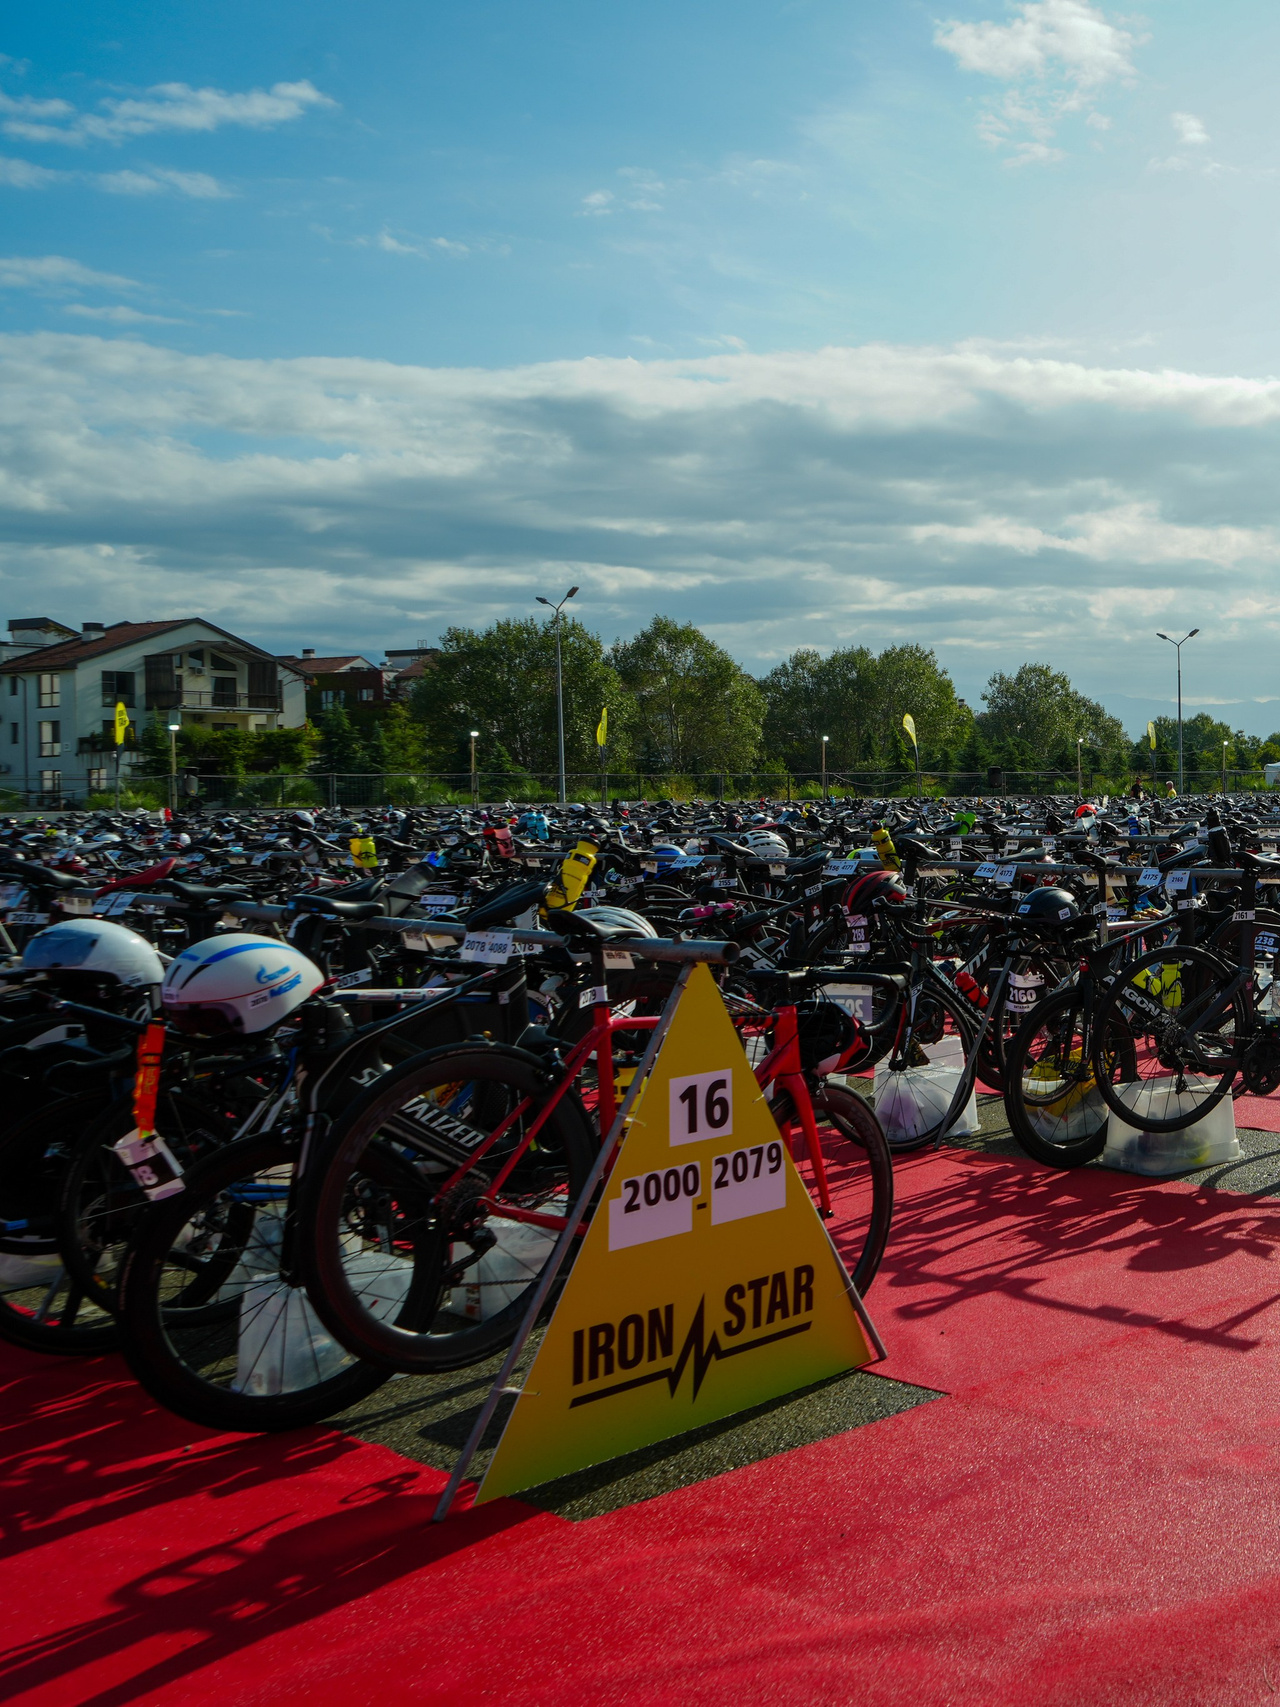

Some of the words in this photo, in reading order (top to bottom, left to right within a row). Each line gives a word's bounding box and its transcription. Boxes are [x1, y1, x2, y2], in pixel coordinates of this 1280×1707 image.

[852, 928, 866, 941] 2158
[465, 940, 485, 952] 2078
[337, 973, 360, 988] 2076
[1009, 986, 1036, 1003] 2160
[679, 1079, 729, 1134] 16
[624, 1164, 699, 1213] 2000
[714, 1142, 782, 1190] 2079
[573, 1304, 674, 1385] IRON
[723, 1265, 815, 1337] STAR
